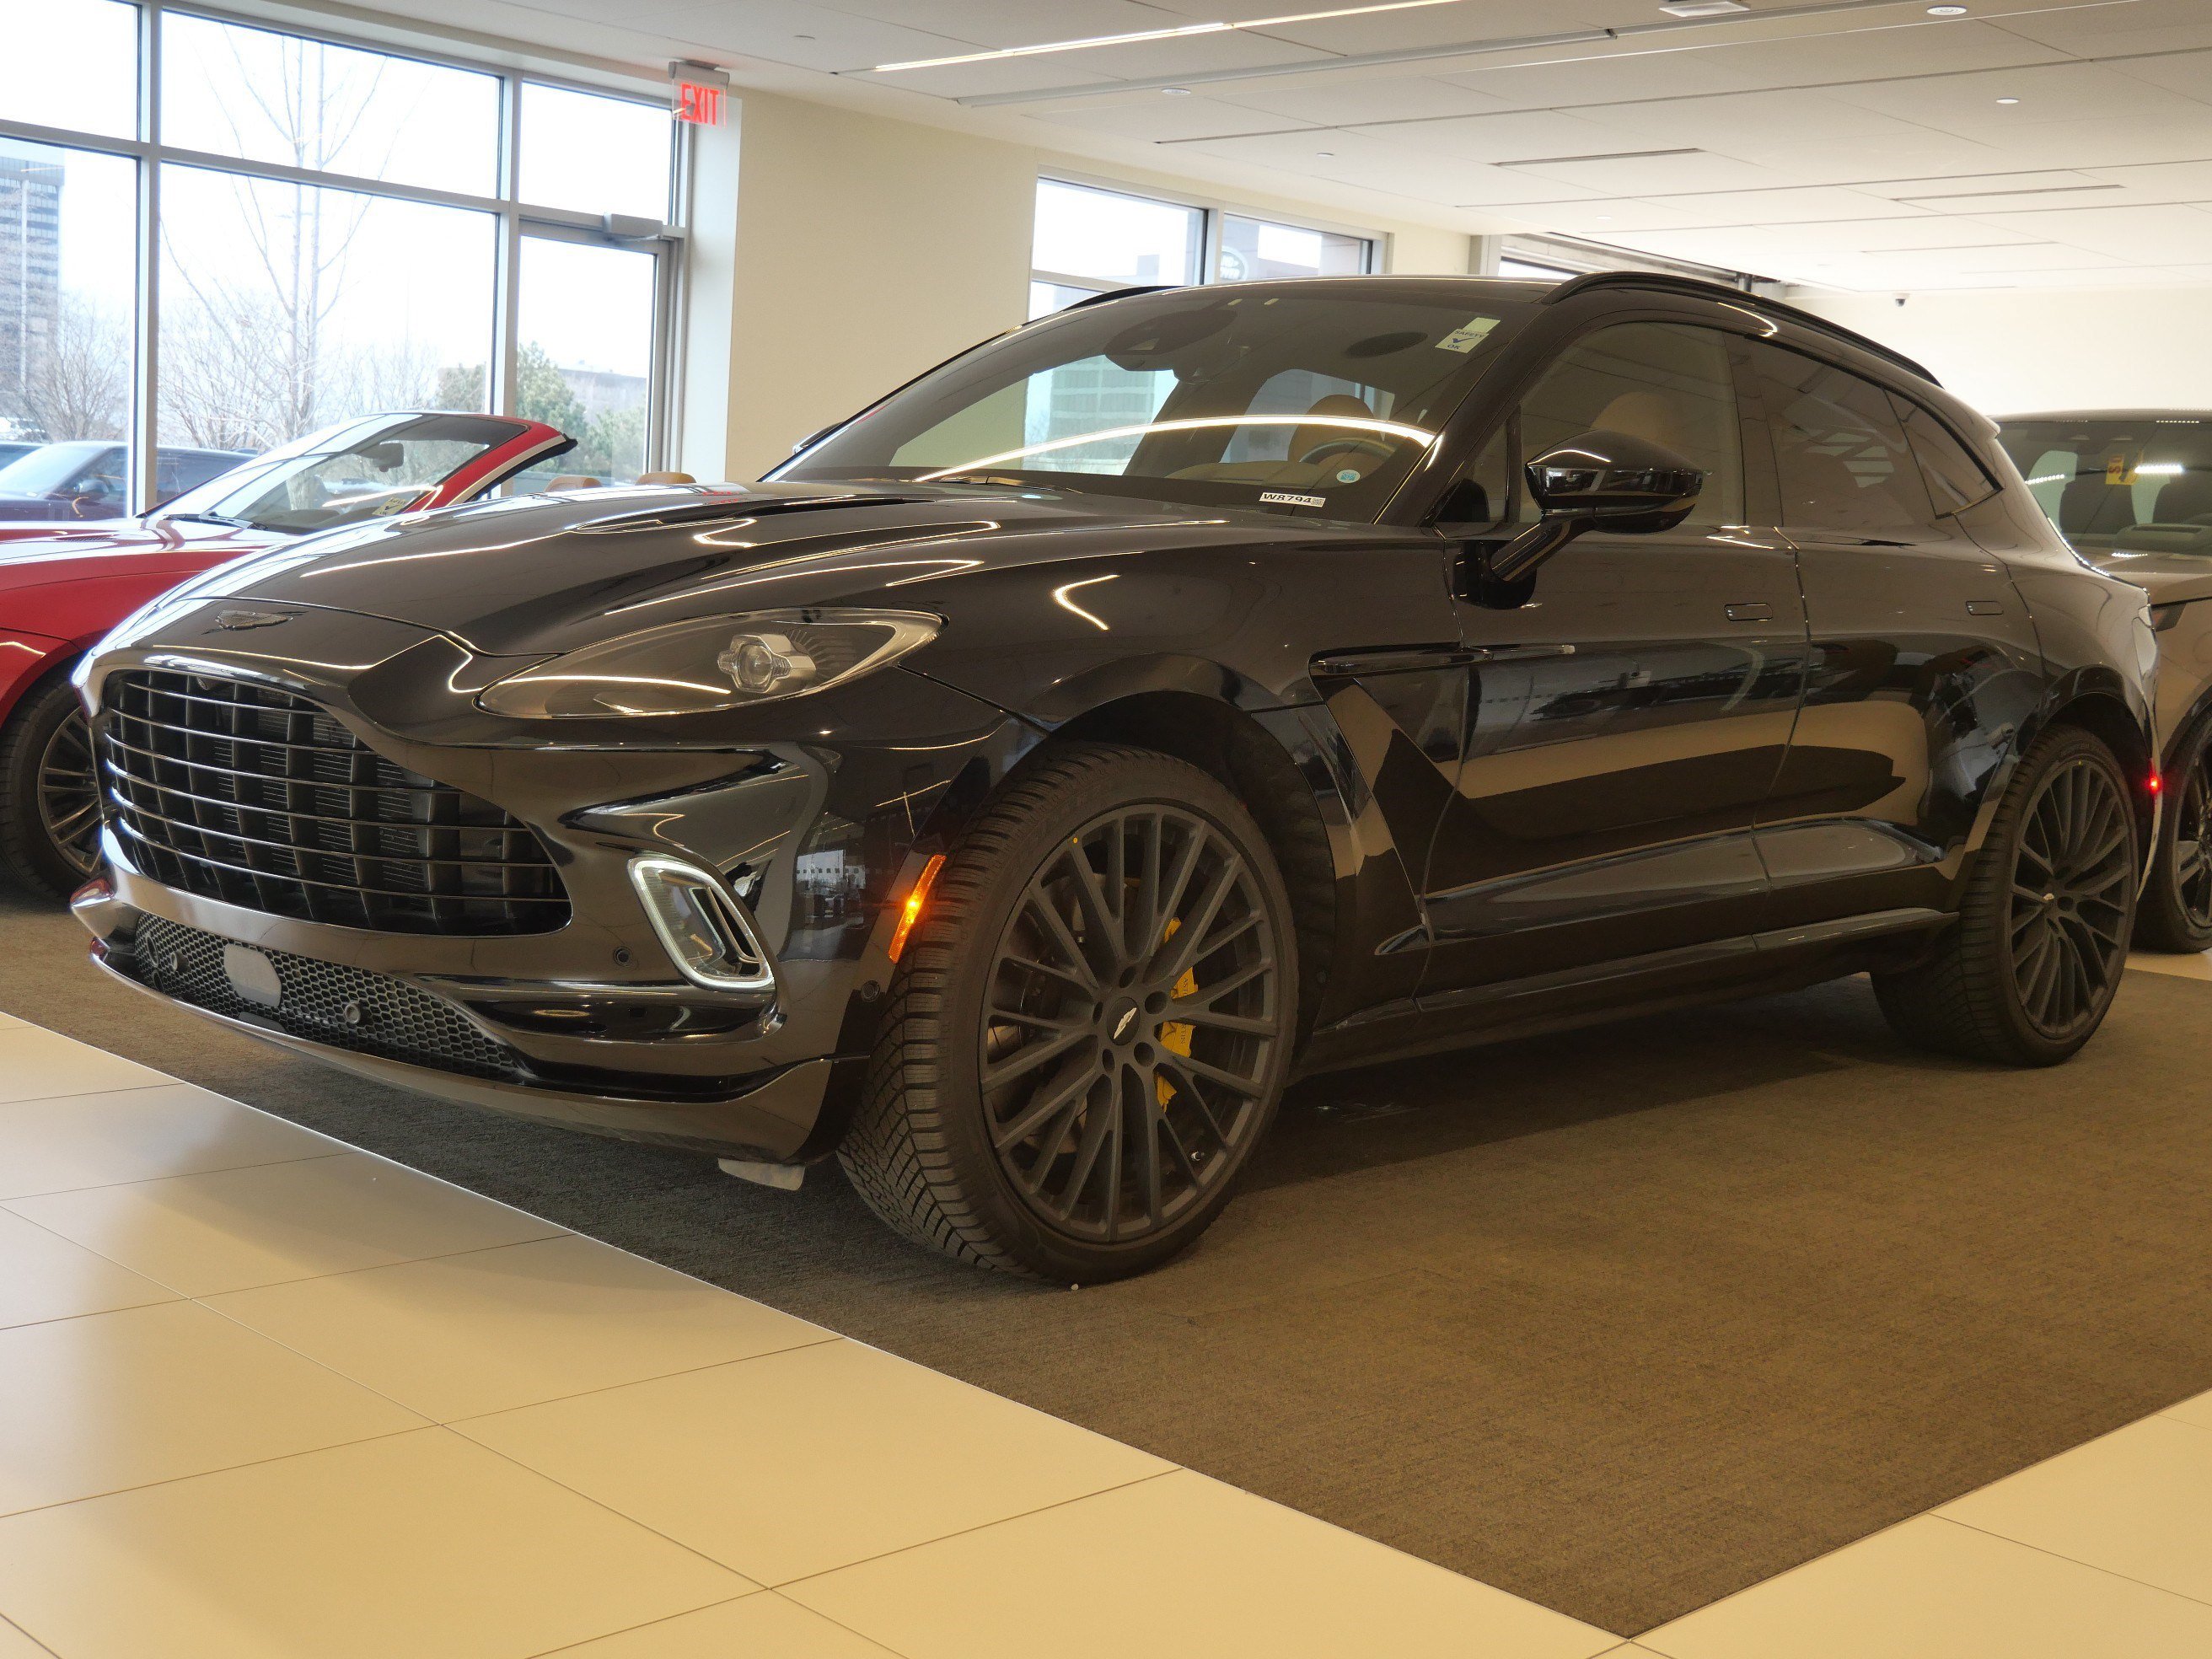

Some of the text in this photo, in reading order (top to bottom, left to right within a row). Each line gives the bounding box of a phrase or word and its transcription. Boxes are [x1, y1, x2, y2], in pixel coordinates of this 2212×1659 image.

[680, 83, 720, 126] EXIT
[1454, 330, 1485, 338] SAFETY
[1264, 493, 1312, 503] W8794
